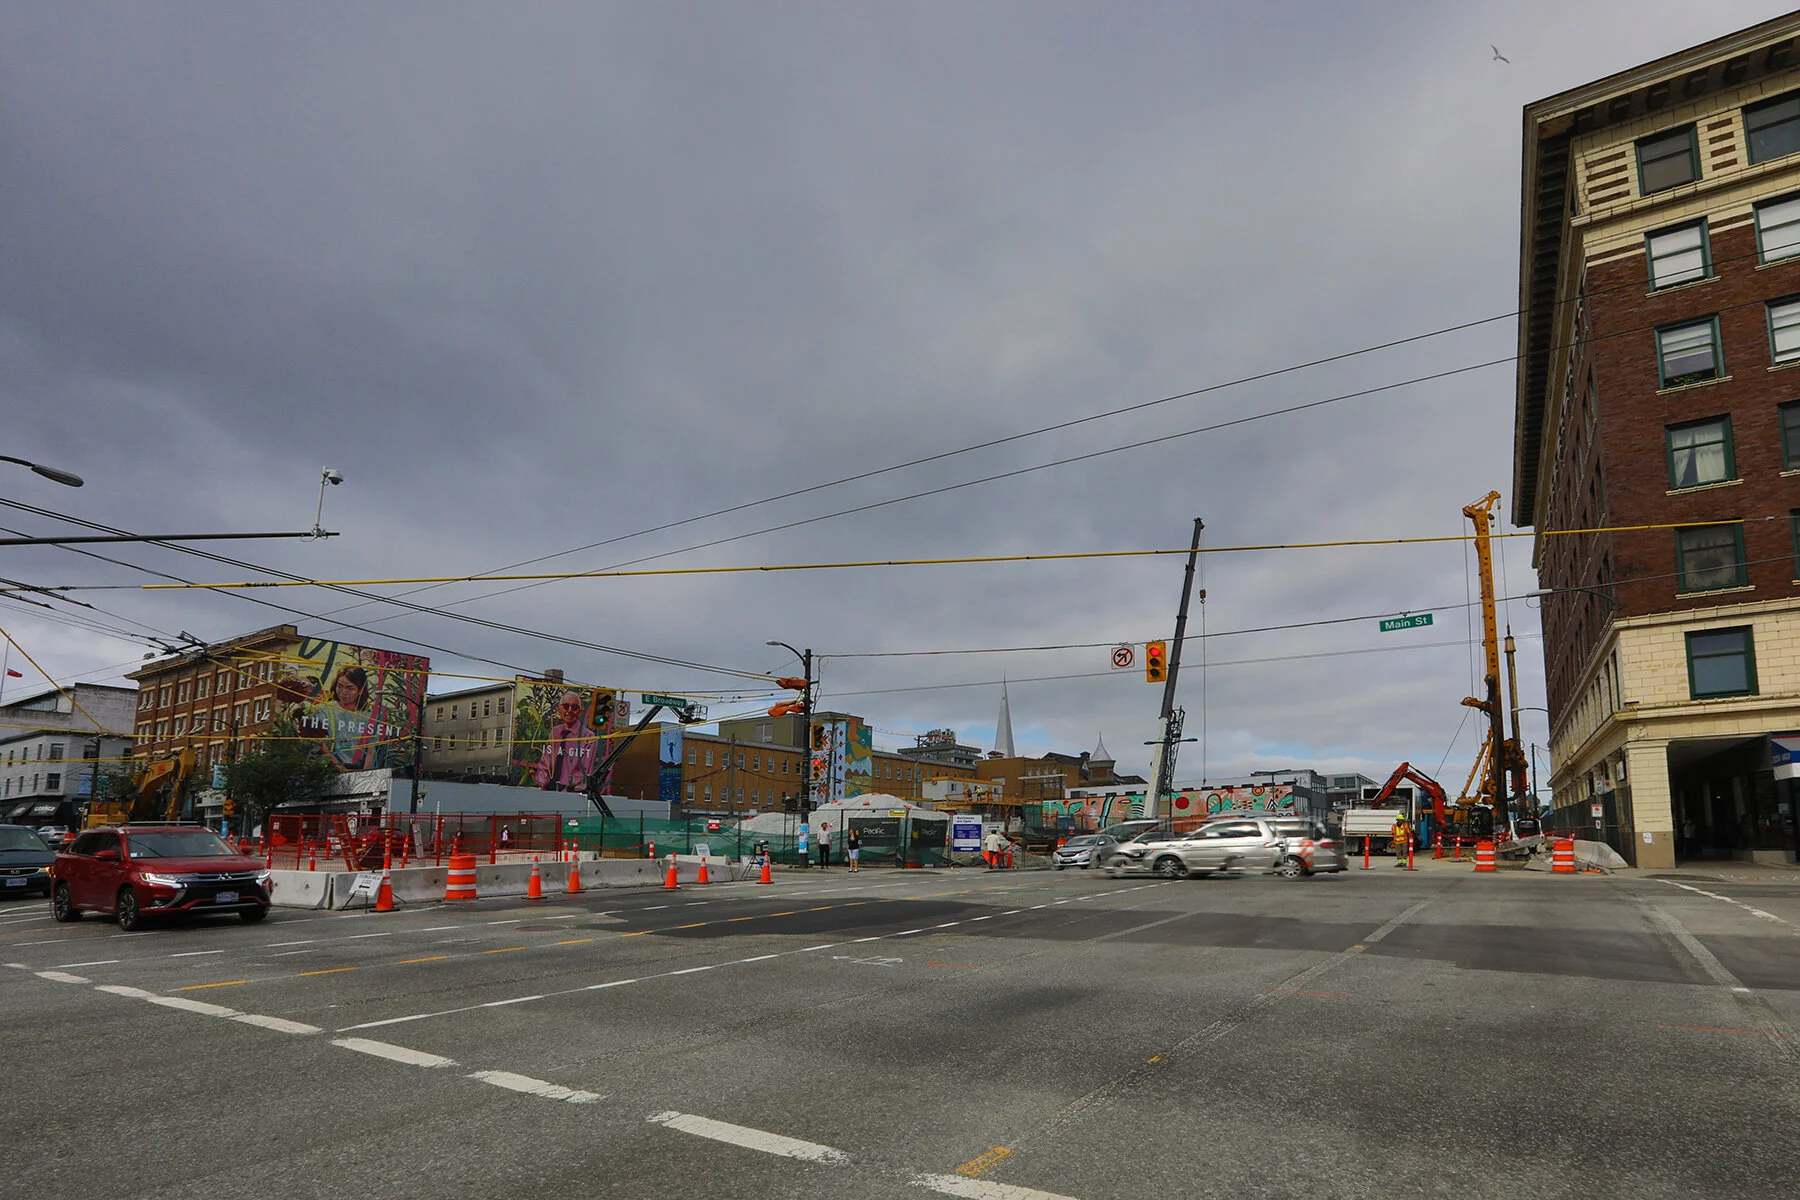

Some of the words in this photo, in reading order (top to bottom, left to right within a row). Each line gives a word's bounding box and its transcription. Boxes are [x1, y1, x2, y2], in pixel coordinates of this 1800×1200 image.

[1385, 620, 1410, 629] Main
[1415, 617, 1427, 625] St
[652, 697, 684, 707] Broadway
[302, 716, 329, 730] THE
[338, 720, 401, 737] PRESENT
[543, 745, 552, 754] IS
[557, 747, 563, 756] A
[569, 748, 591, 758] GIFT
[863, 827, 885, 835] Pacific
